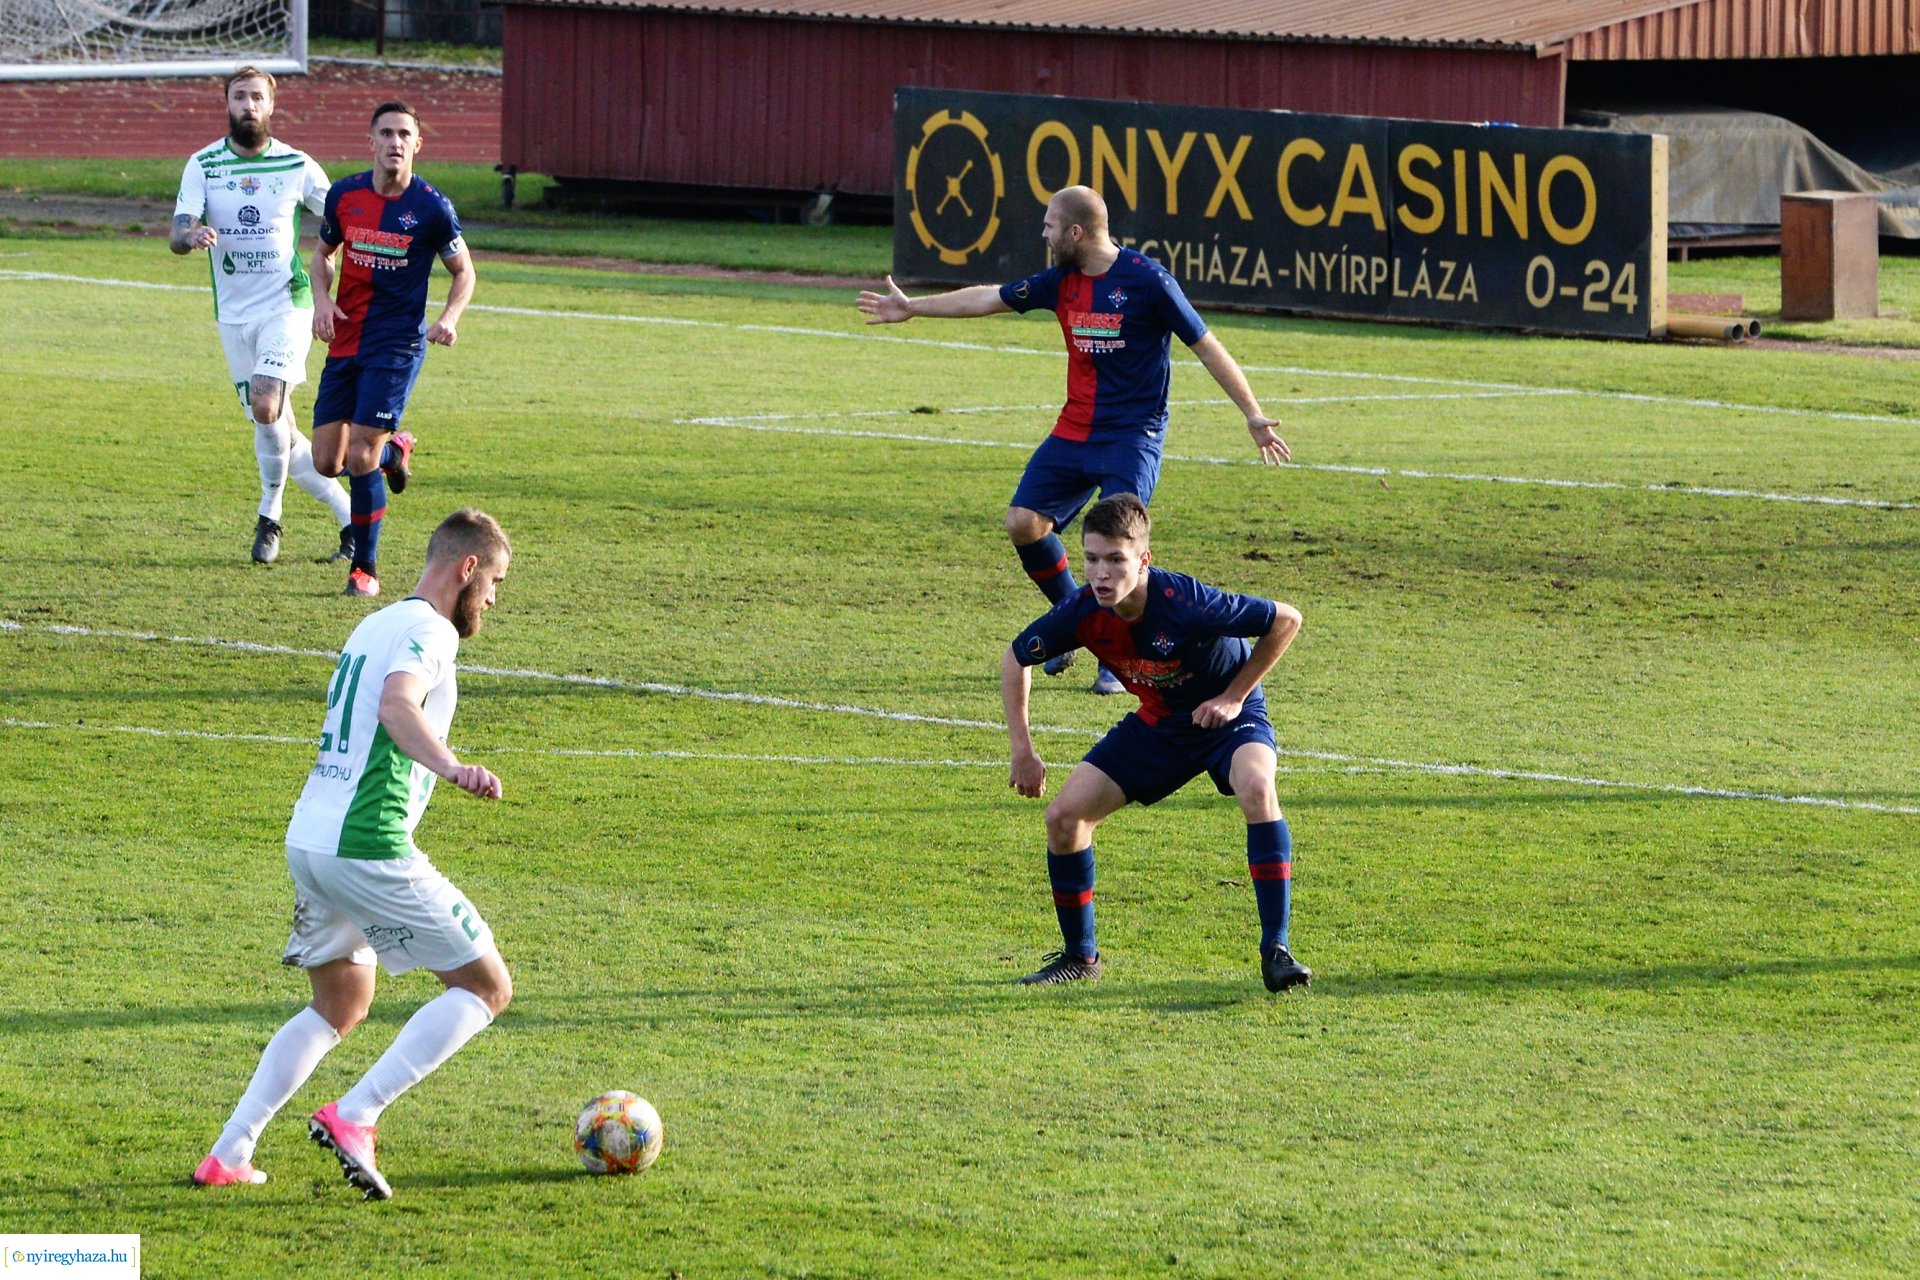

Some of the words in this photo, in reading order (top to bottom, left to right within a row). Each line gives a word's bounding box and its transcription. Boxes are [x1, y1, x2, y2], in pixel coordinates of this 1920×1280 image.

[1026, 120, 1253, 220] ONYX
[1276, 137, 1598, 246] CASINO
[231, 251, 254, 260] FINO
[255, 251, 280, 259] FRISS
[247, 260, 266, 268] KFT.
[1525, 254, 1639, 315] 0-24
[319, 652, 367, 754] 21
